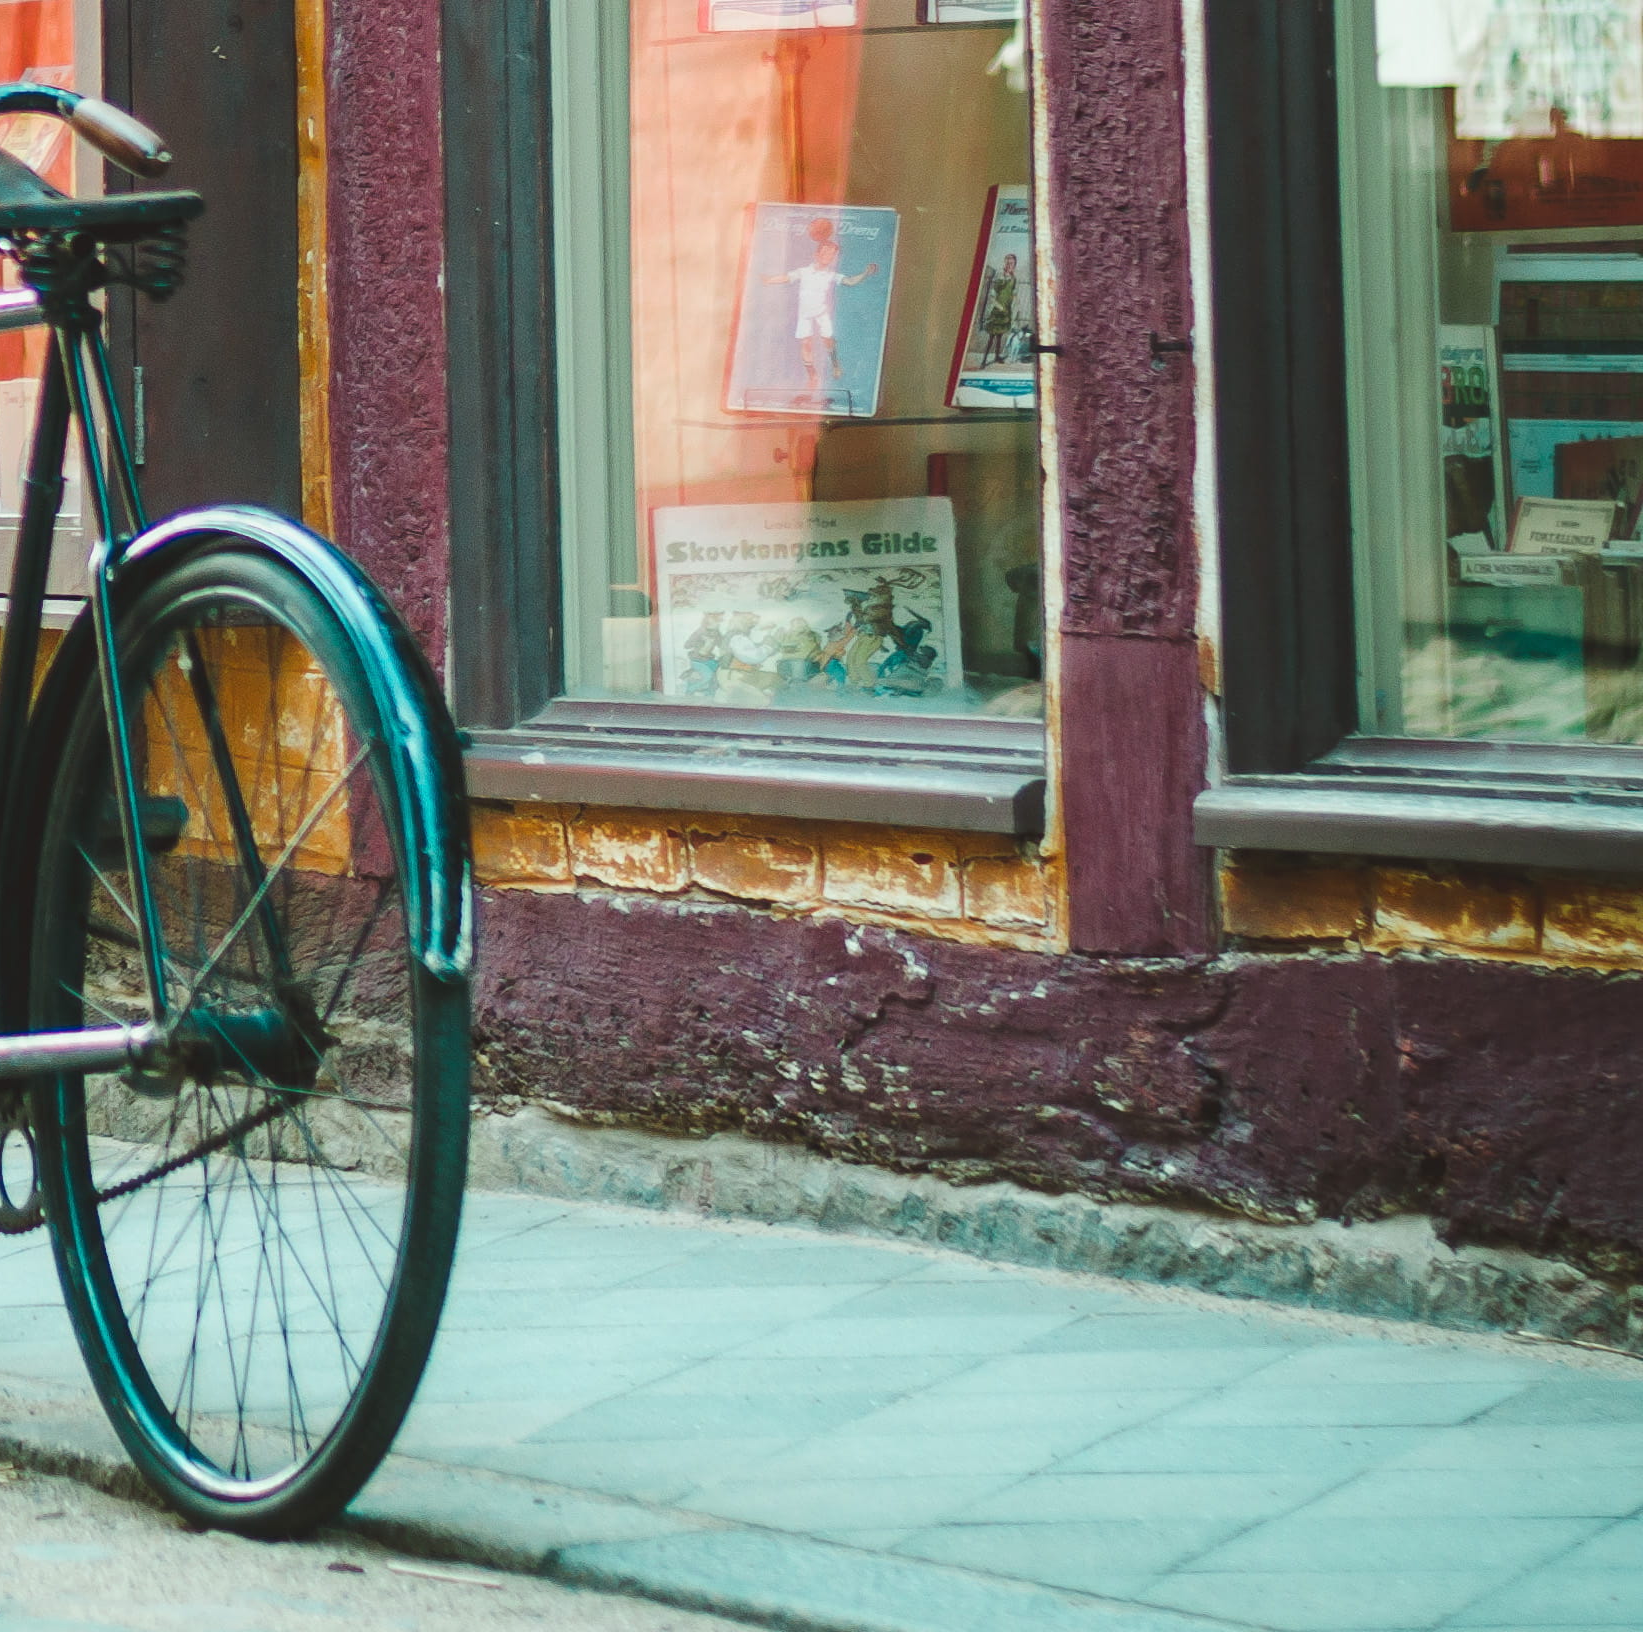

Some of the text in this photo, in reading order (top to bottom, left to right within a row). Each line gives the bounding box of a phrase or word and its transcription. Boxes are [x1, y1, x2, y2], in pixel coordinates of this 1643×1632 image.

[837, 220, 880, 241] Dreng
[665, 531, 939, 564] Skovkongens Gilde
